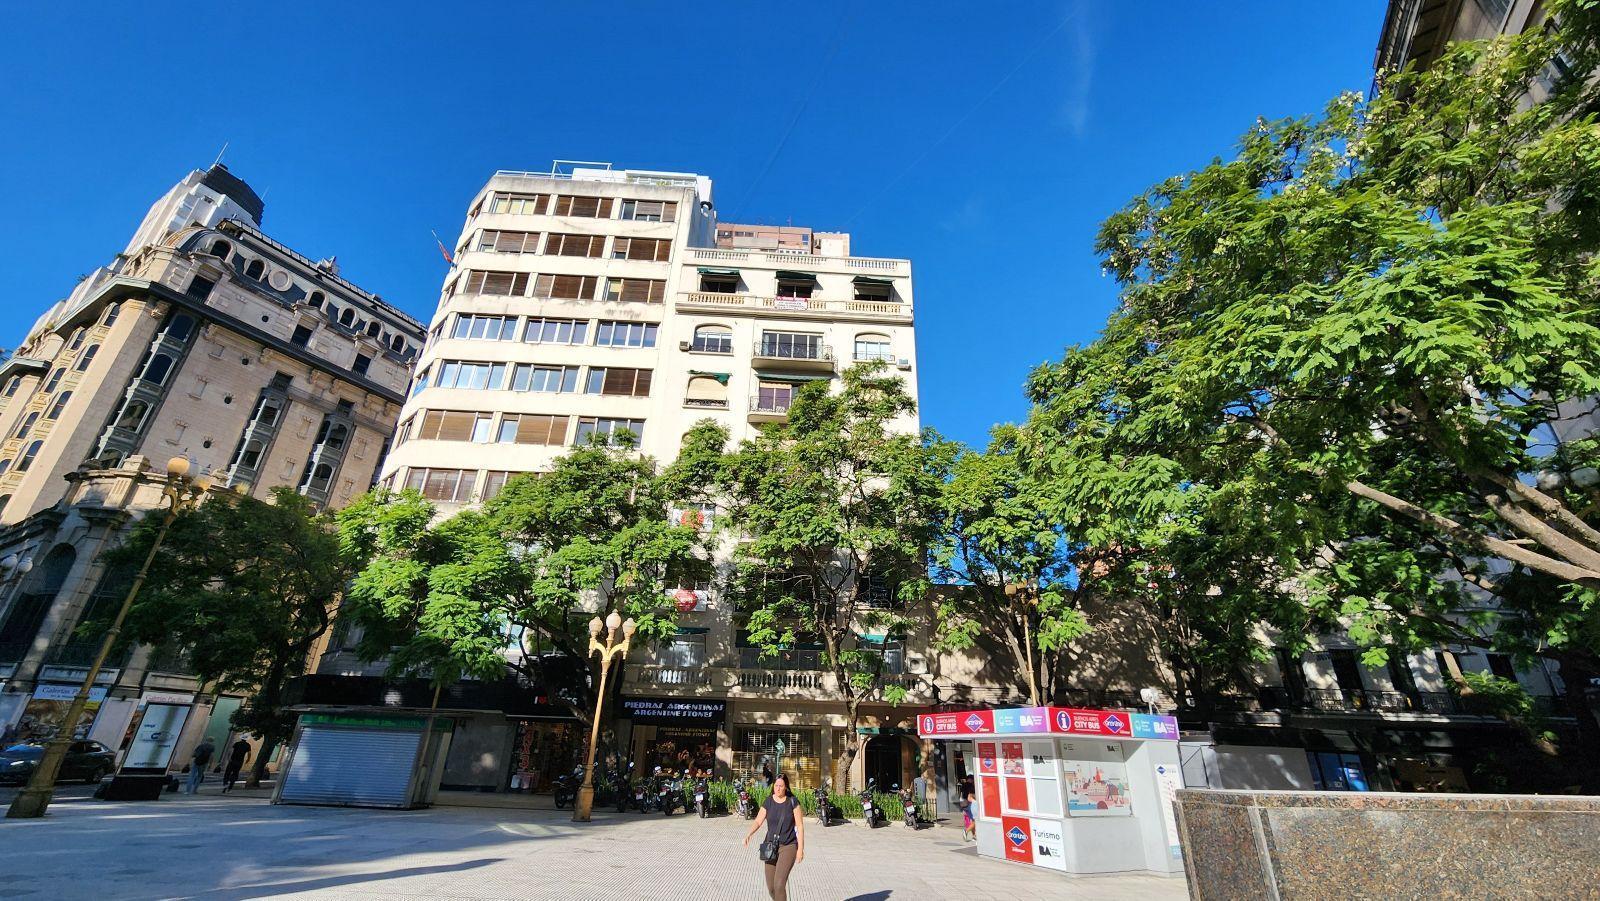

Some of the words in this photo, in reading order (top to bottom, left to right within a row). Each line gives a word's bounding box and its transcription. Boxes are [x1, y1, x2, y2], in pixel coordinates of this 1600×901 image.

[624, 701, 664, 709] PIEDRAS
[667, 703, 725, 711] ARGENTINAS
[633, 709, 681, 717] ARGENTINE
[1019, 715, 1034, 726] BA
[1088, 721, 1100, 729] BUS
[1153, 721, 1168, 733] BA
[1032, 755, 1046, 765] BA
[1033, 829, 1060, 840] Turismo
[1038, 845, 1052, 857] BA
